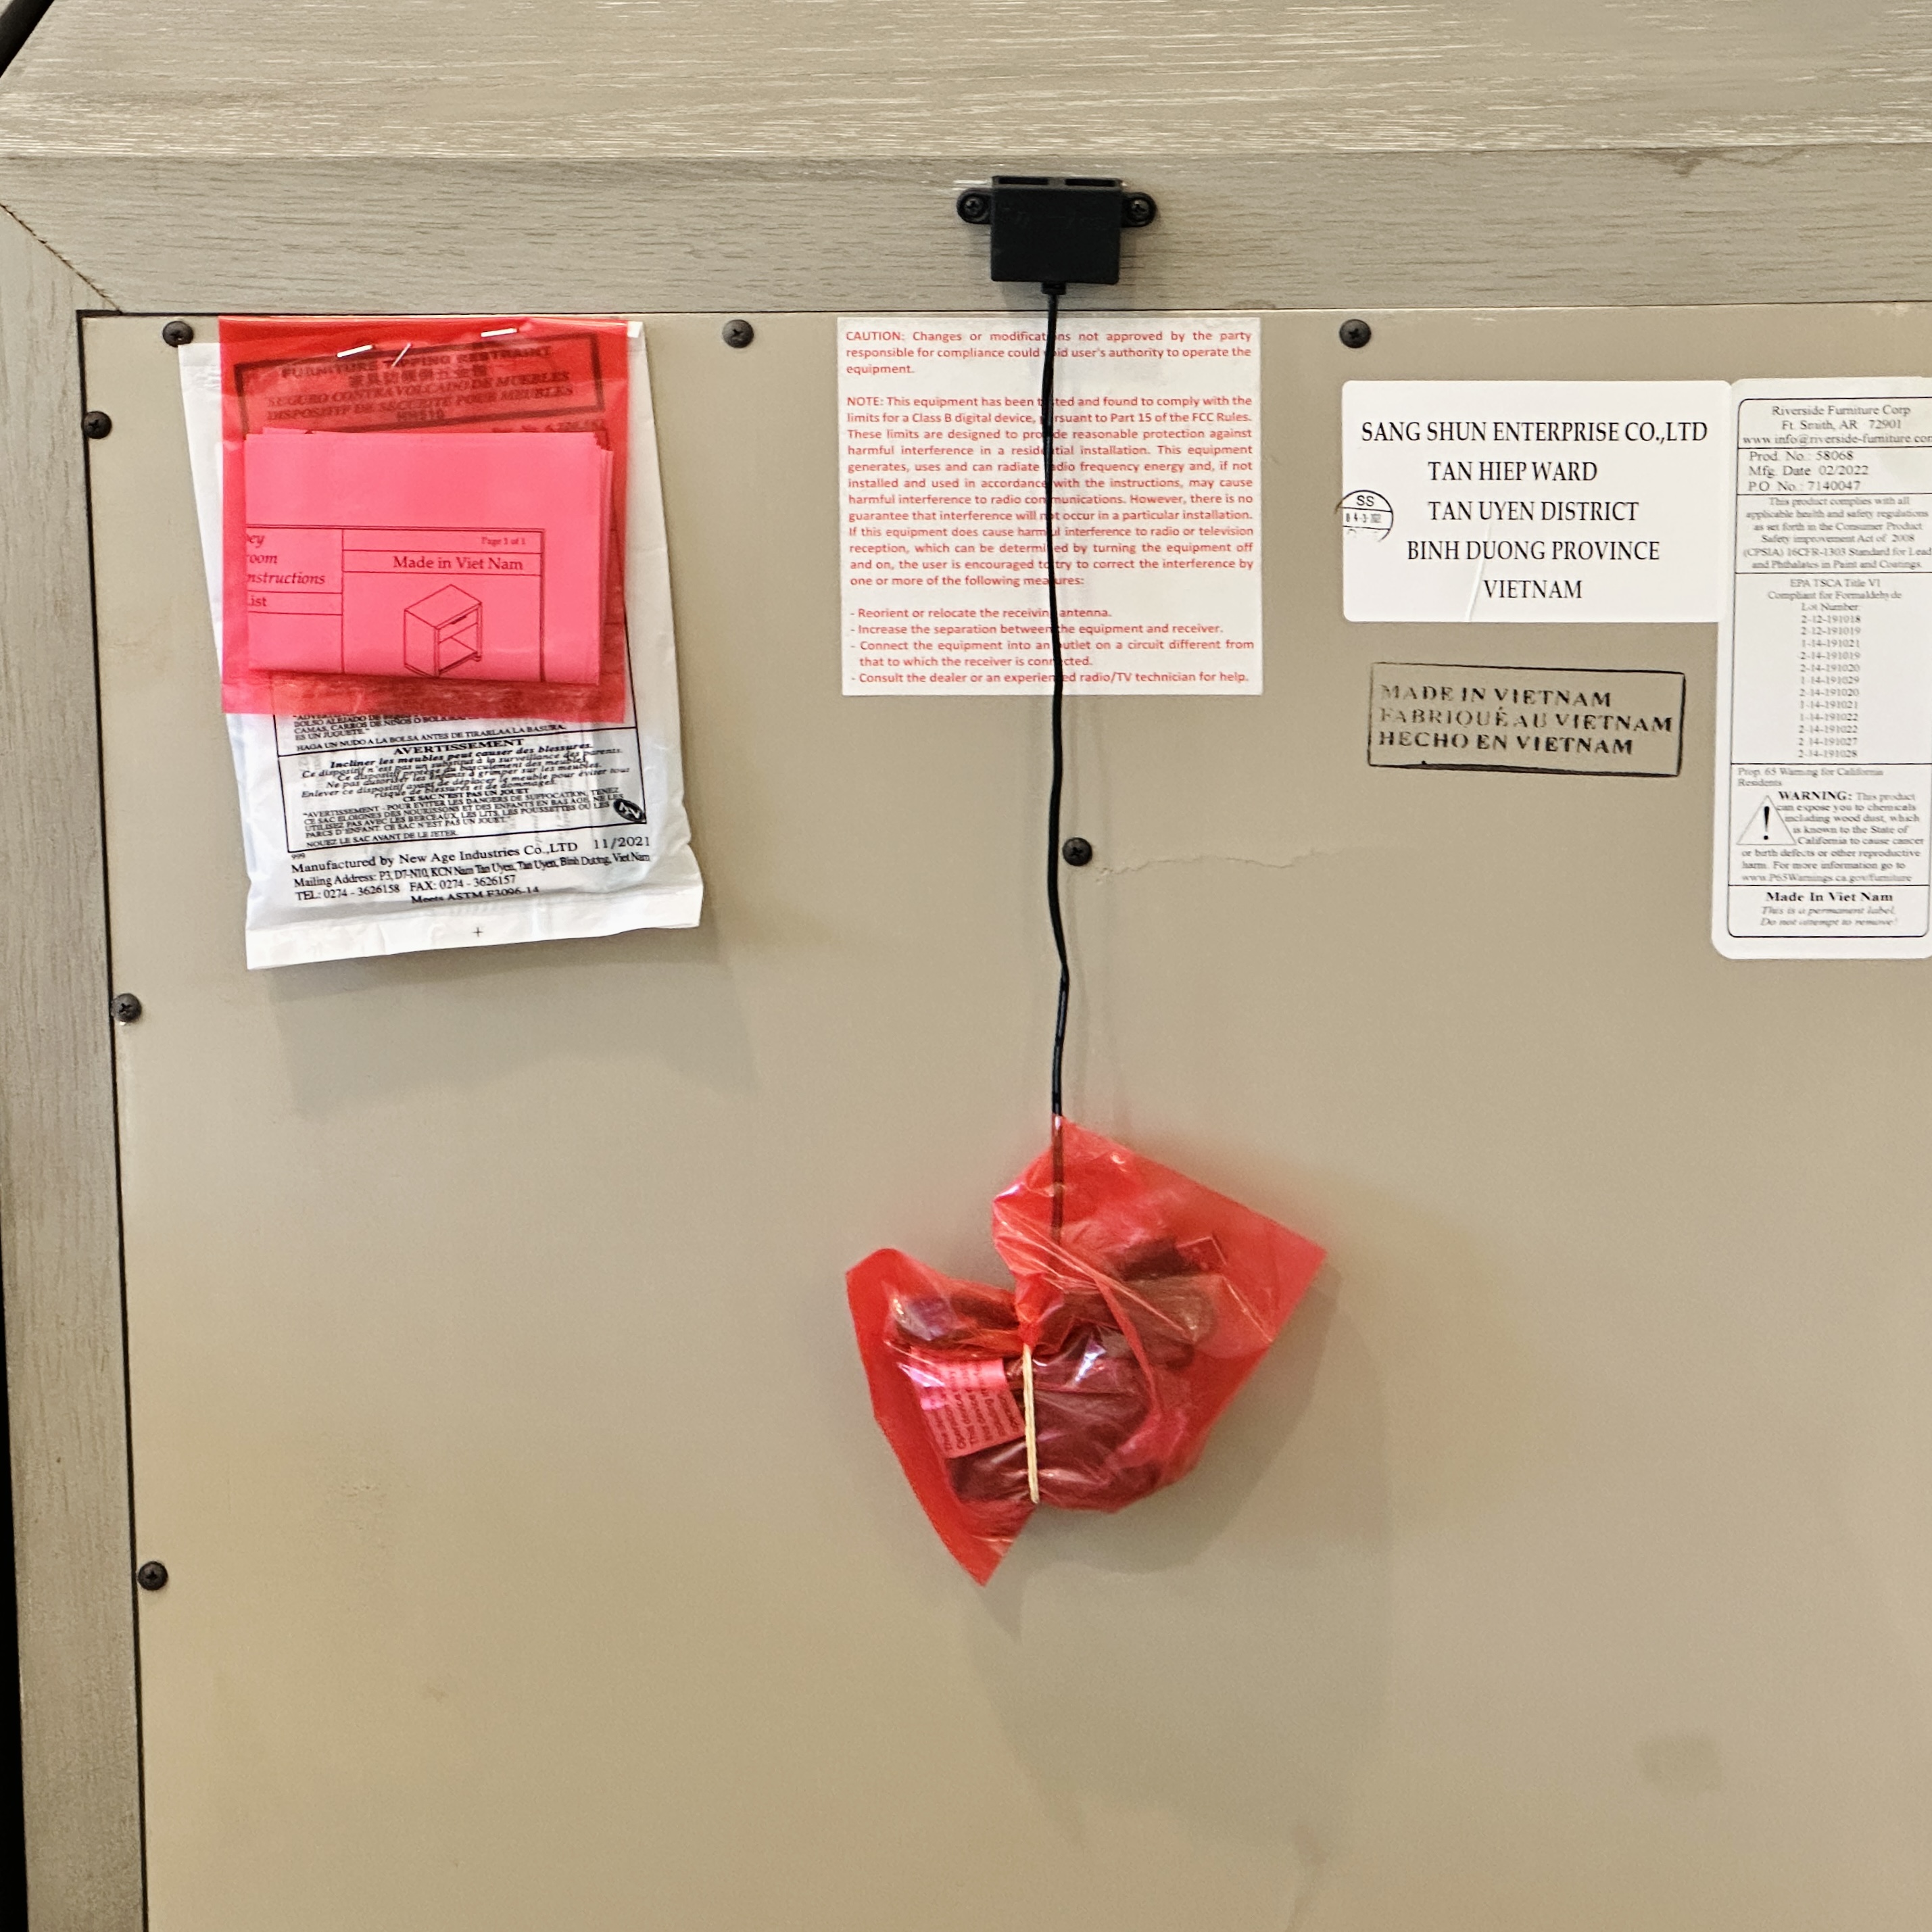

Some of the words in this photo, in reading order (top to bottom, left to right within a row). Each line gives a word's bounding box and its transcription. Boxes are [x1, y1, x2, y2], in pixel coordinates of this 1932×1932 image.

[846, 331, 905, 341] CAUTION:
[912, 331, 963, 343] Changes
[969, 333, 982, 341] or
[990, 331, 1071, 341] modificatns
[1079, 333, 1099, 341] not
[1106, 332, 1163, 343] approved
[1170, 331, 1185, 343] by
[1192, 331, 1213, 341] the
[1219, 331, 1251, 343] party
[846, 347, 915, 359] responsible
[917, 347, 934, 357] for
[937, 348, 1005, 359] compliance
[1007, 348, 1040, 358] could
[1071, 349, 1106, 358] user's
[1108, 347, 1164, 359] authority
[1167, 348, 1180, 357] to
[1182, 347, 1229, 359] operate
[1232, 347, 1251, 356] the
[846, 365, 915, 375] equipment.
[847, 396, 884, 406] NOTE:
[886, 396, 911, 406] This
[913, 397, 978, 408] equipment
[981, 397, 1002, 407] has
[1004, 397, 1034, 407] been
[1037, 397, 1075, 408] tted
[1078, 397, 1100, 408] and
[1103, 396, 1138, 408] found
[1140, 397, 1154, 407] to
[1156, 397, 1200, 408] comply
[1202, 395, 1230, 406] with
[1232, 395, 1252, 406] the
[1772, 406, 1824, 416] Riverside
[1827, 406, 1879, 416] Furniture
[1839, 419, 1859, 430] AR
[1868, 419, 1902, 430] 72901
[848, 429, 882, 439] These
[886, 429, 919, 439] limits
[923, 431, 943, 439] are
[947, 429, 1001, 441] designed
[1005, 431, 1019, 439] to
[1022, 429, 1068, 441] prode
[1072, 429, 1138, 440] reasonable
[1142, 429, 1205, 440] protection
[1209, 429, 1252, 441] against
[1361, 421, 1420, 441] SANG
[1426, 421, 1487, 441] SHUN
[1493, 421, 1619, 441] ENTERPRISE
[1624, 421, 1708, 445] CO.,LTD
[1815, 450, 1854, 461] 58068
[1427, 461, 1472, 481] TAN
[1478, 461, 1526, 481] HIEP
[1532, 461, 1598, 481] WARD
[1782, 465, 1812, 477] Date
[1818, 464, 1870, 476] 02/2022
[1808, 480, 1862, 491] 7140047
[1356, 495, 1374, 507] SS
[1427, 501, 1472, 521] TAN
[1478, 501, 1534, 521] UYEN
[1540, 501, 1639, 521] DISTRICT
[1407, 540, 1459, 560] BINH
[1466, 540, 1546, 561] DUONG
[1551, 540, 1660, 561] PROVINCE
[393, 556, 435, 569] Made
[437, 556, 452, 569] in
[455, 556, 484, 570] Viet
[487, 557, 524, 571] Nam
[1483, 579, 1583, 599] VIETNAM
[858, 608, 909, 619] Reorient
[912, 610, 925, 619] or
[927, 608, 977, 619] relocate
[979, 608, 1000, 619] the
[1002, 609, 1051, 618] receivin
[1059, 608, 1112, 619] antenna.
[859, 673, 904, 683] Consult
[907, 673, 926, 683] the
[929, 673, 967, 683] dealer
[986, 675, 1001, 683] an
[1003, 671, 1076, 684] experiened
[1080, 671, 1132, 683] radio/TV
[1135, 672, 1196, 682] technician
[1199, 671, 1217, 681] for
[1219, 671, 1249, 683] help.
[1380, 684, 1454, 702] MADE
[1462, 687, 1486, 702] IN
[1495, 688, 1612, 708] VIETNAM
[1514, 714, 1547, 729] AU
[1554, 713, 1674, 733] VIETNAM
[392, 738, 525, 756] AVERTISSEMENT
[1379, 731, 1468, 749] HECHO
[1476, 734, 1507, 750] EN
[1516, 735, 1633, 756] VIETNAM
[1778, 791, 1853, 800] WARNING:
[290, 856, 377, 874] Manufactured
[379, 855, 395, 868] by
[398, 852, 427, 865] New
[430, 852, 456, 865] Age
[459, 846, 520, 861] Industries
[594, 836, 650, 850] 11/2021
[295, 890, 321, 902] TEL:
[323, 888, 348, 899] 0274
[357, 884, 400, 897] 3626158
[408, 881, 437, 892] FAX:
[439, 879, 465, 890] 0274
[473, 874, 516, 888] 3626157
[410, 895, 445, 904] Meets
[448, 890, 484, 902] ASTM
[1765, 892, 1805, 902] Made
[1810, 892, 1824, 902] In
[1829, 891, 1856, 902] Viet
[1861, 892, 1893, 902] Nam
